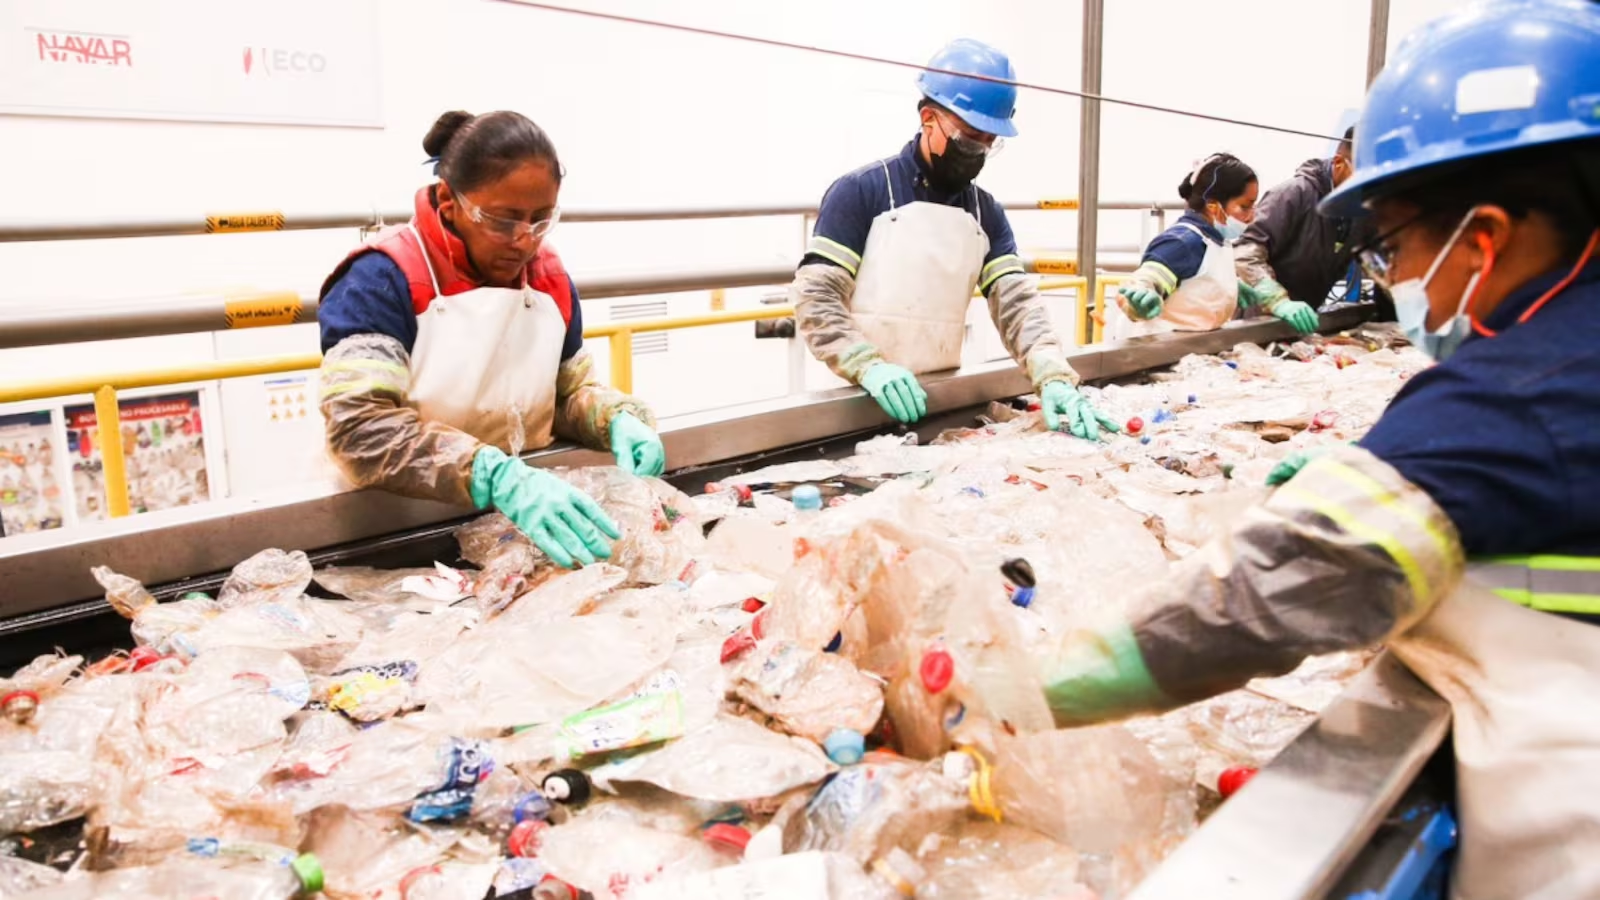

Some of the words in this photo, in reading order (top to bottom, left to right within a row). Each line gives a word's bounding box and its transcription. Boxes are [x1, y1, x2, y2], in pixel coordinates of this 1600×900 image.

[272, 48, 327, 73] ECO
[228, 216, 244, 228] AGUA
[245, 214, 274, 227] CALIENTE
